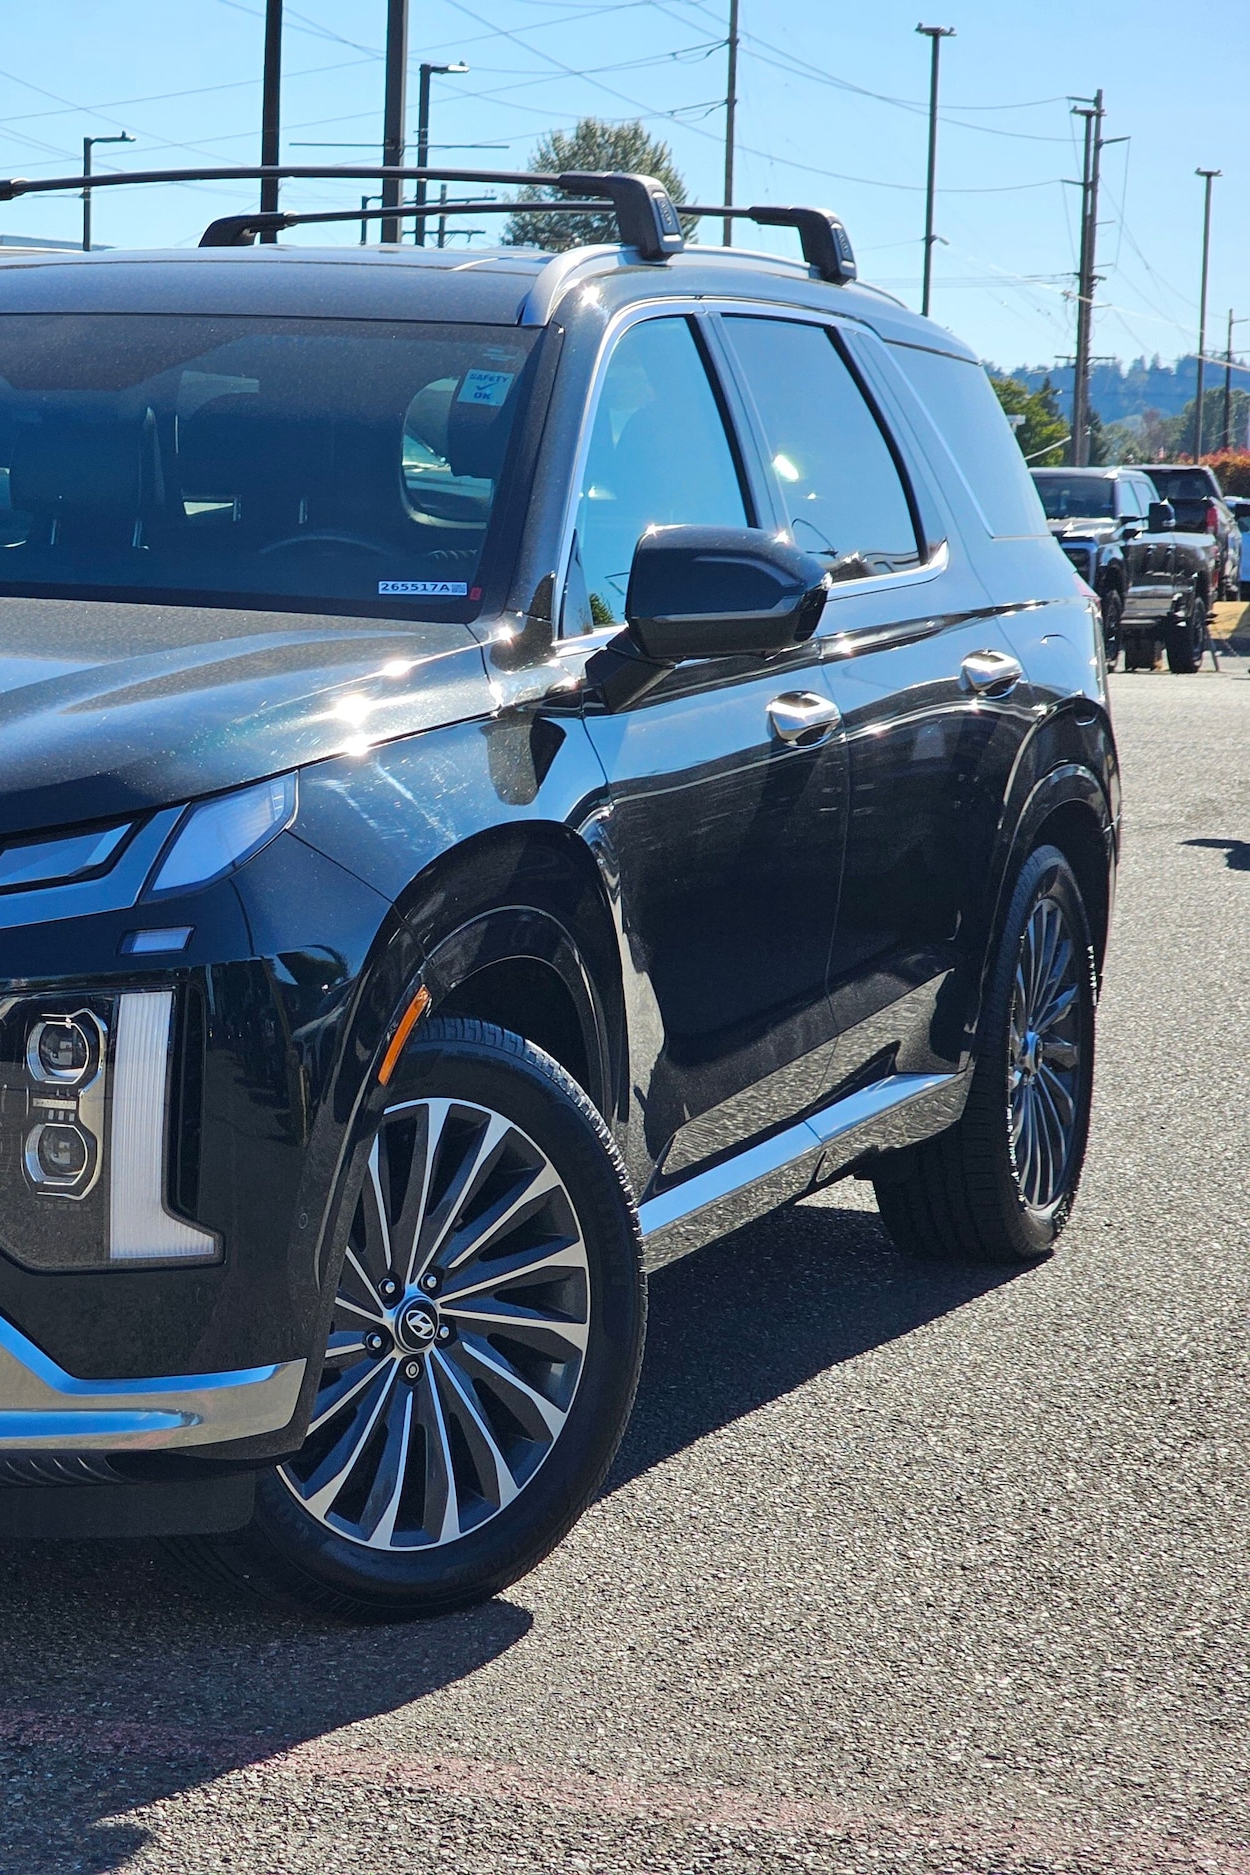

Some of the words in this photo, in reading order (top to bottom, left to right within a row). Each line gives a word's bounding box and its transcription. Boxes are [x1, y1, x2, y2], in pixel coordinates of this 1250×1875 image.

[470, 373, 509, 382] SAFETY
[474, 391, 493, 400] OK
[381, 582, 450, 592] 265517A
